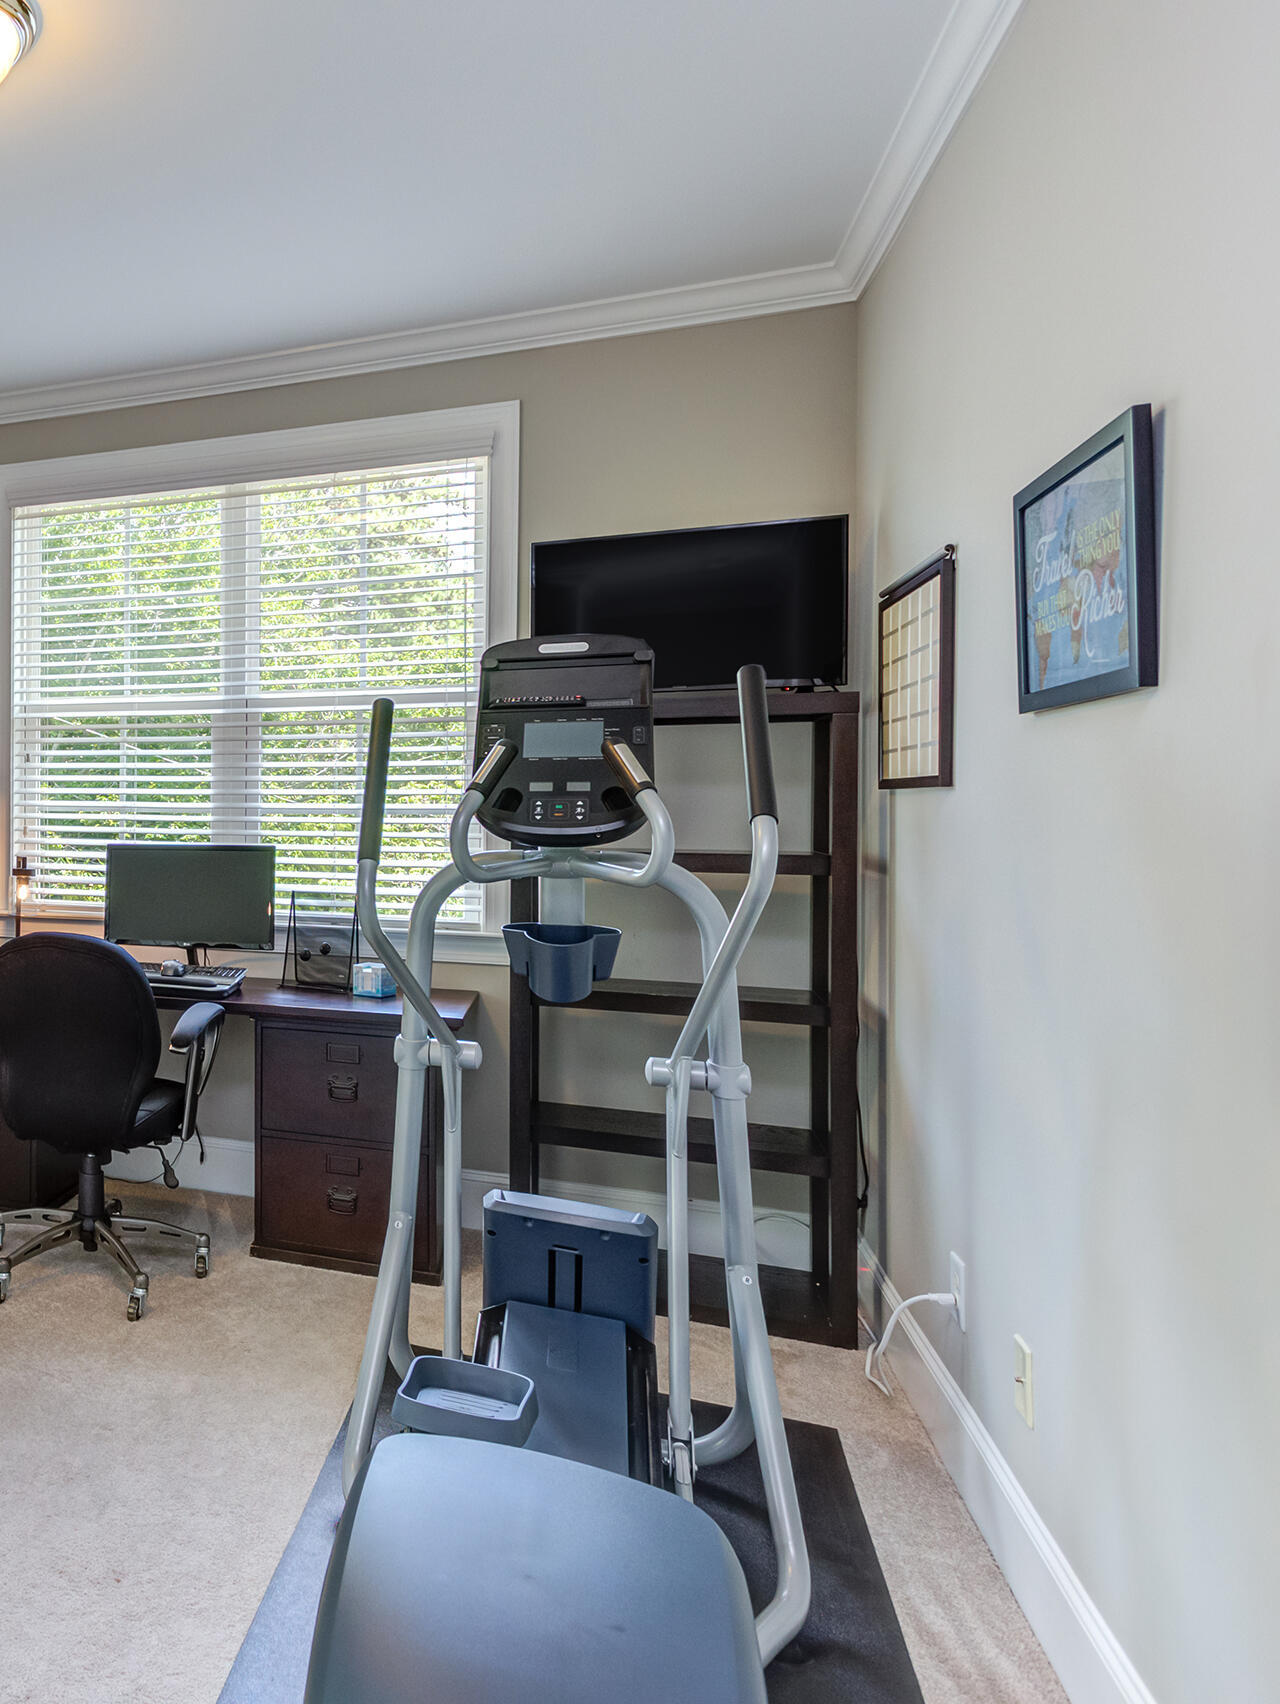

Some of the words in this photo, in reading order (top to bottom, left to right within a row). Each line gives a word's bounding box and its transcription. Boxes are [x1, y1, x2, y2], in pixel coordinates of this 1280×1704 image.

[1078, 538, 1103, 568] THING
[1102, 529, 1121, 557] YOU
[1085, 519, 1098, 545] THE
[1099, 508, 1121, 537] ONLY
[1033, 530, 1076, 593] Travel
[1071, 568, 1126, 658] Richer
